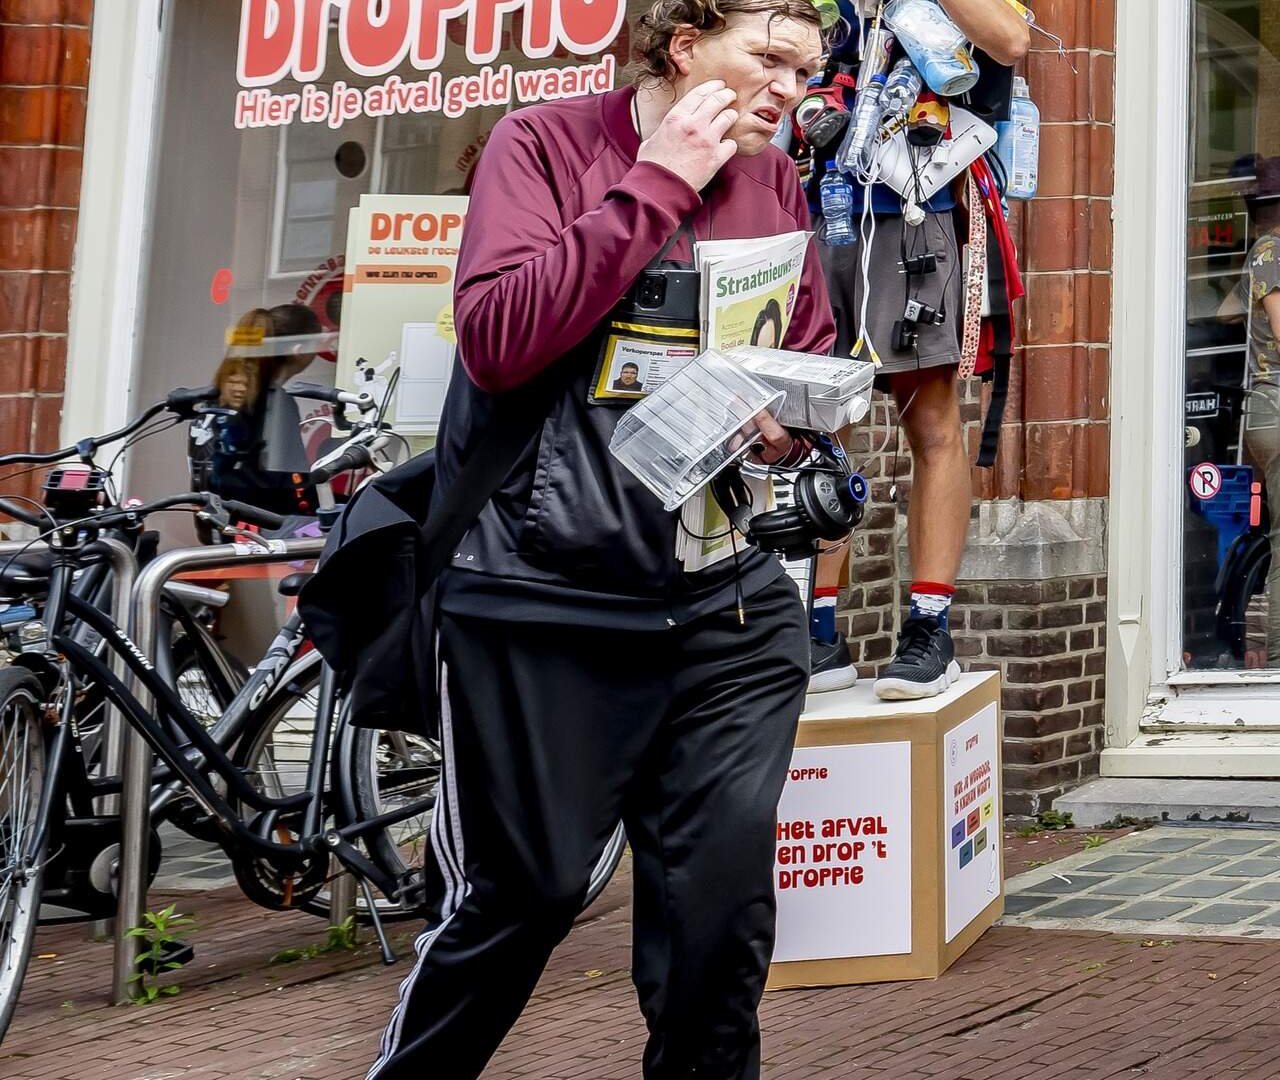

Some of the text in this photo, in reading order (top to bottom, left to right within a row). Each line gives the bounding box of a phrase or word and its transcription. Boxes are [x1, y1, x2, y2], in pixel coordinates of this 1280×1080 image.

[237, 58, 612, 126] Hier is je afval geld waard
[370, 212, 467, 242] Drop
[716, 257, 792, 298] Straatnieuws
[250, 622, 305, 711] GIAN
